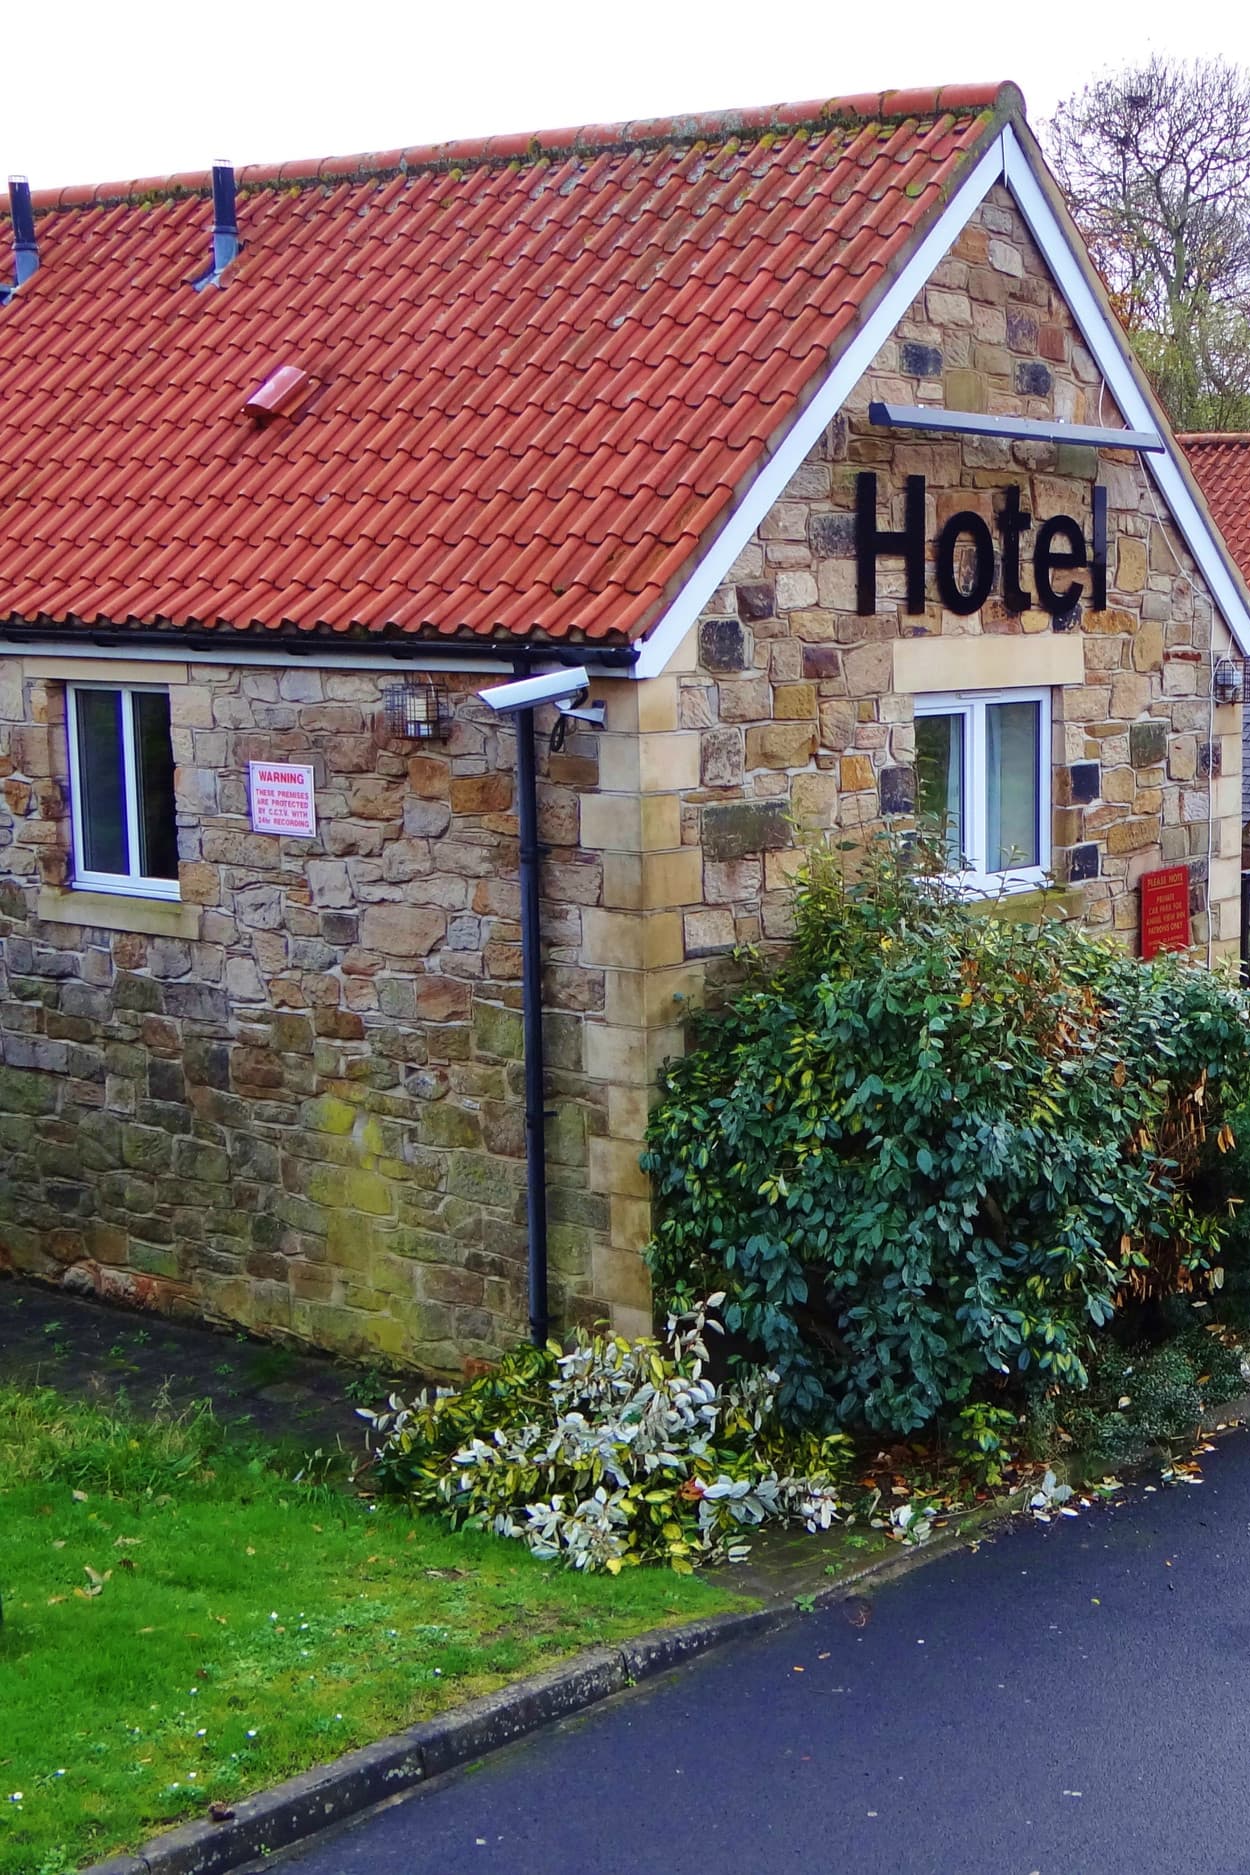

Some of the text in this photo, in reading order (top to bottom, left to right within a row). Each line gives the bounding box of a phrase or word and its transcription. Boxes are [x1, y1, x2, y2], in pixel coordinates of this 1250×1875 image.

[856, 471, 1107, 616] Hotel
[258, 770, 304, 784] WARNING
[256, 789, 309, 800] THESE PREMISES
[272, 800, 308, 809] PROTECTED
[274, 818, 309, 828] RECORDING
[1148, 873, 1183, 888] PLEASE NOTE
[1170, 921, 1183, 931] ONLY
